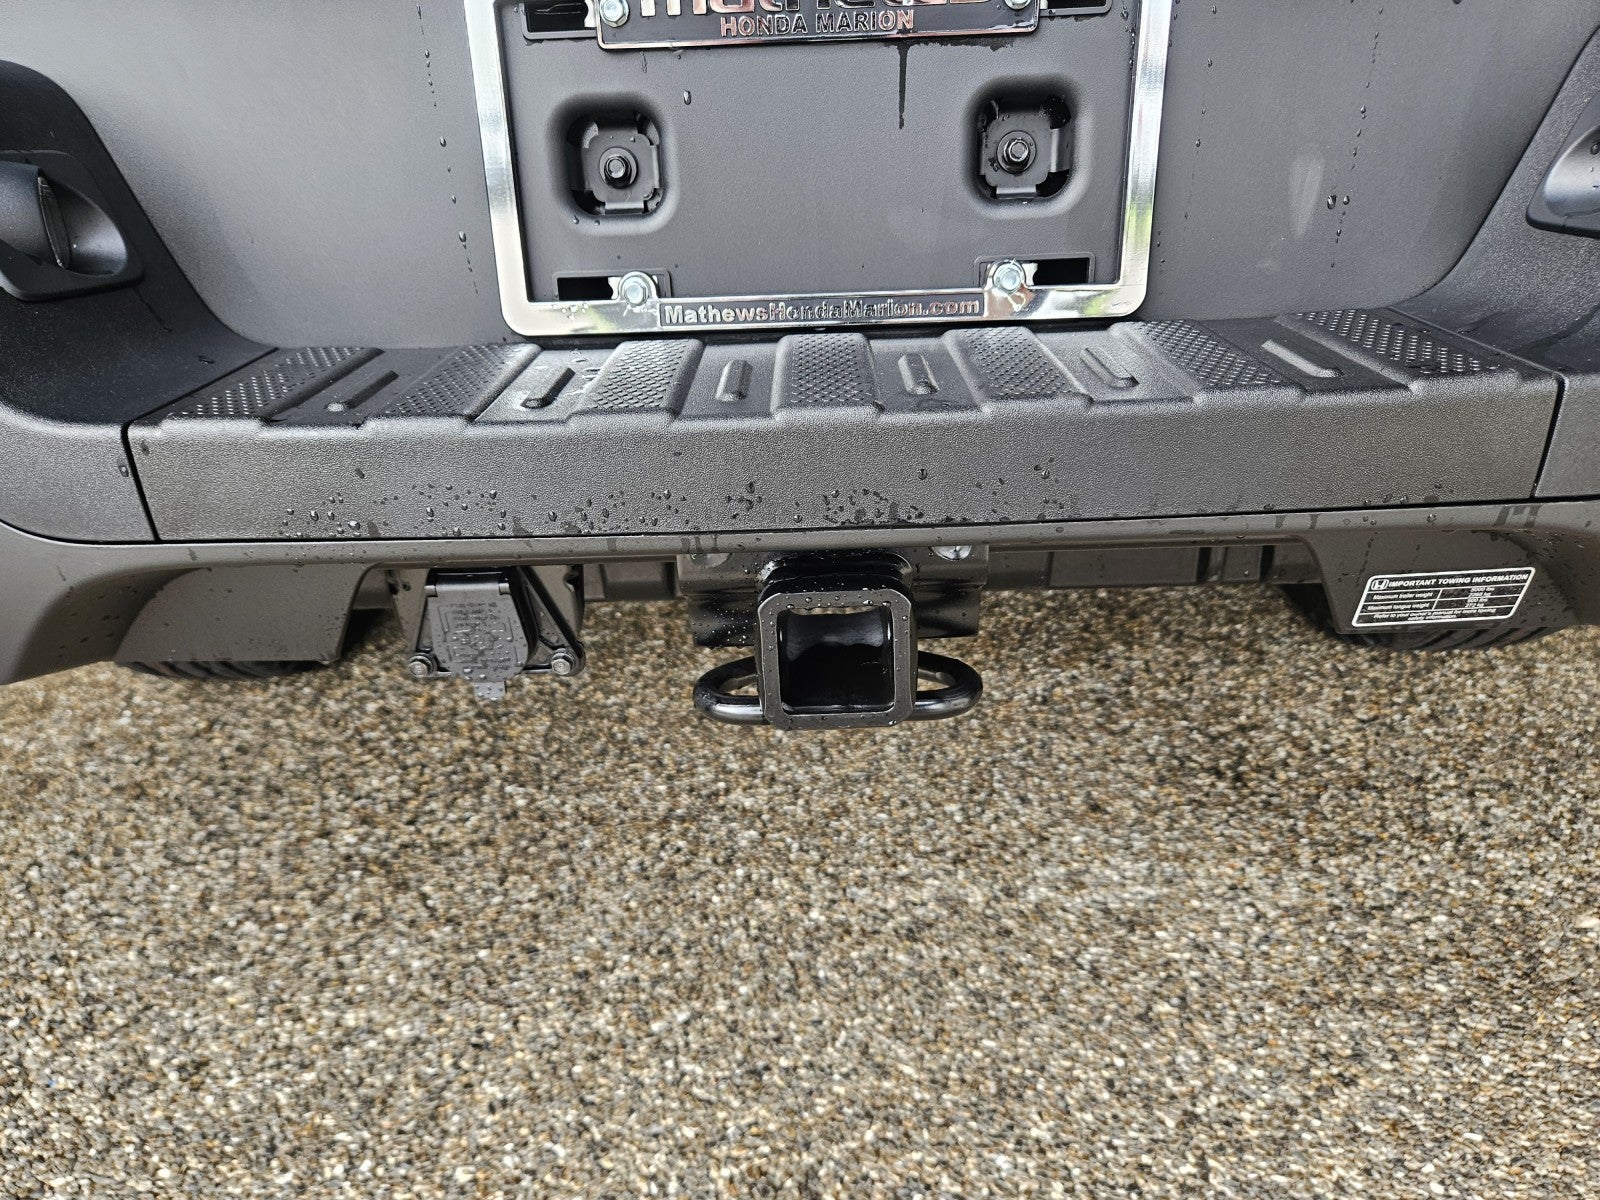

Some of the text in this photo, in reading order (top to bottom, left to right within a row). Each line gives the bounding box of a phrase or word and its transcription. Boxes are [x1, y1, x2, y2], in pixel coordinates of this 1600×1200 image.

[720, 9, 914, 37] HONDA MARION
[664, 299, 980, 324] MathewsHondaMarion.com
[1389, 574, 1528, 587] IMPORTANT TOWING INFORMATION
